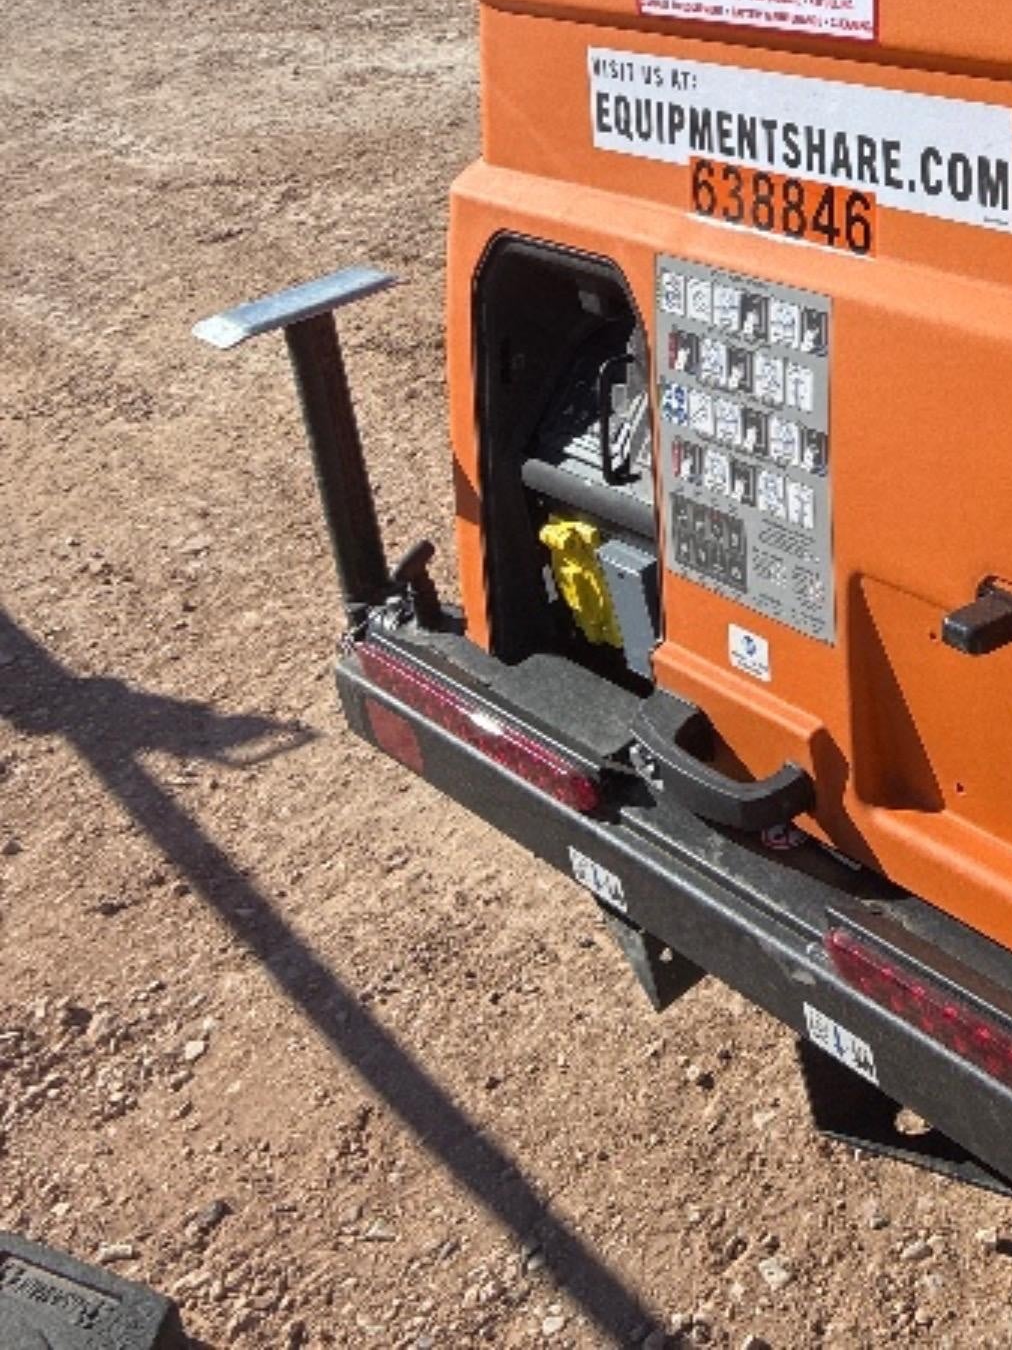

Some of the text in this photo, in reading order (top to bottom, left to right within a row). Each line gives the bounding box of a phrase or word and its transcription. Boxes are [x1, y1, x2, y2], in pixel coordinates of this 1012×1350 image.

[592, 57, 698, 91] VISIT US AT:
[595, 91, 1009, 211] EQUIPMENTSHARE.COM
[691, 160, 873, 254] 638846
